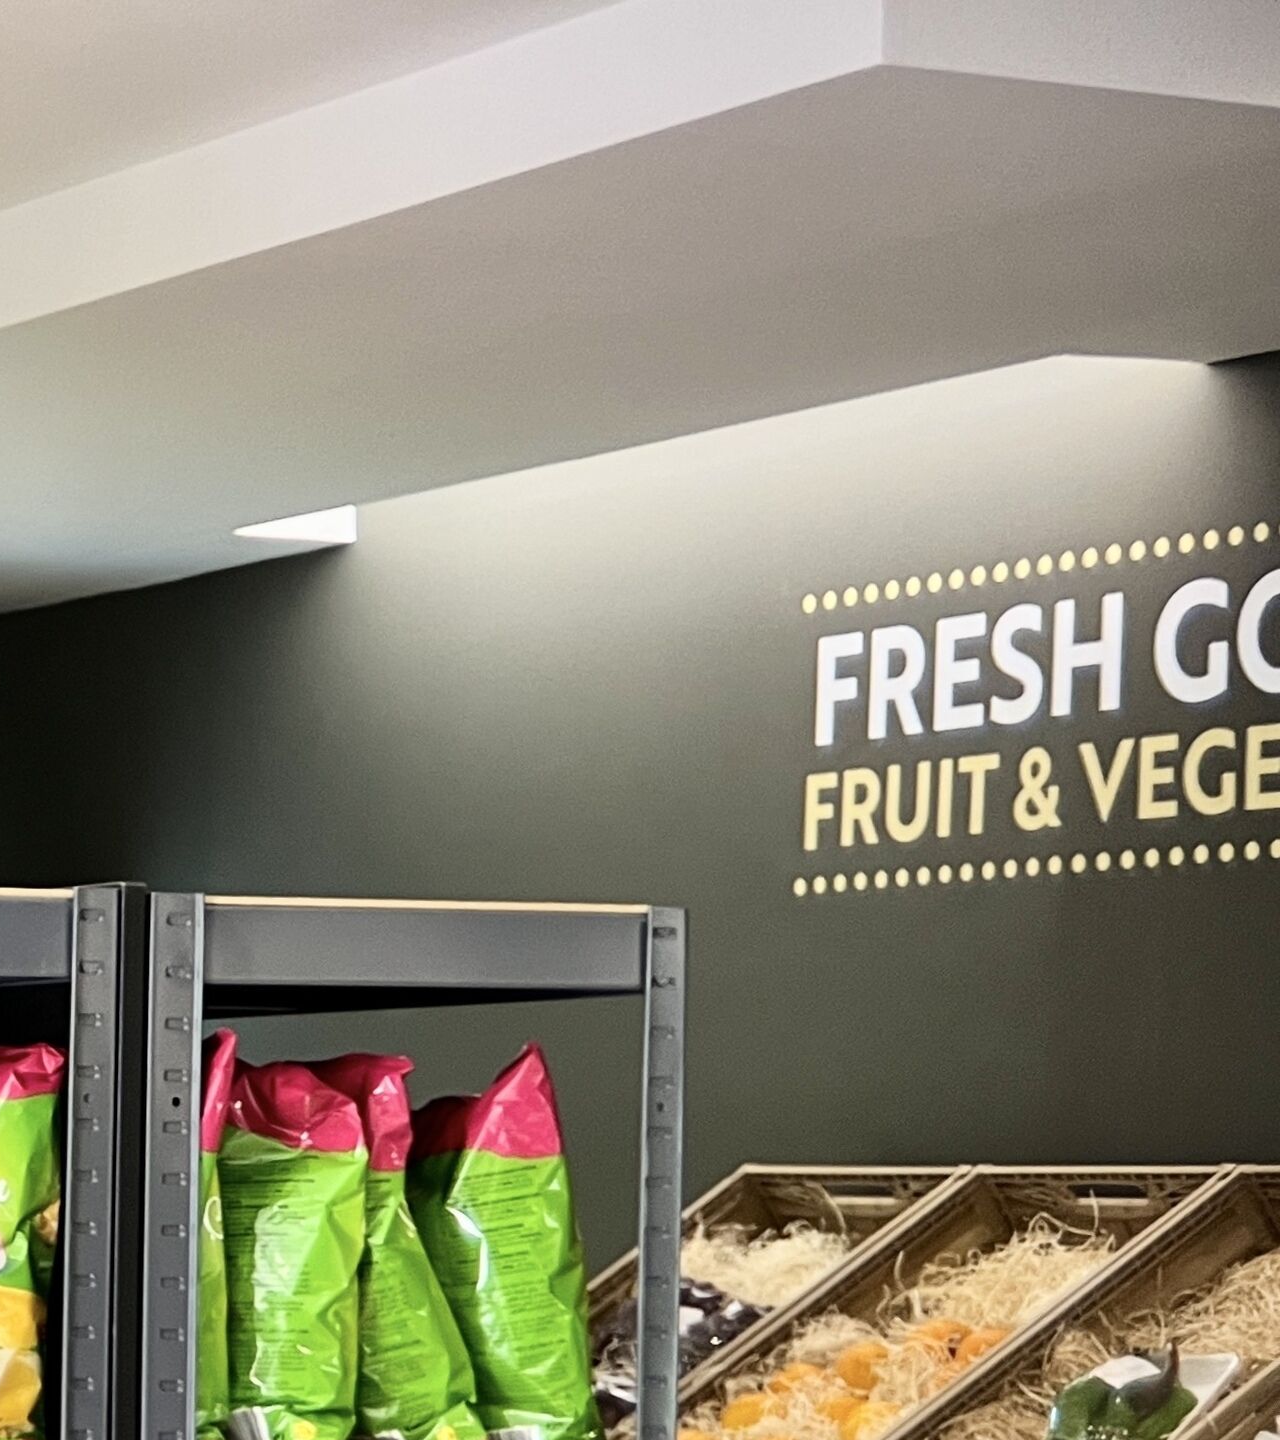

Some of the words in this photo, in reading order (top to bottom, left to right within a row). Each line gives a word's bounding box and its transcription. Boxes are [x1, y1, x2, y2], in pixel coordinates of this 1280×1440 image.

[813, 590, 1125, 748] FRESH
[802, 752, 1001, 852] FRUIT
[1012, 746, 1063, 832] &
